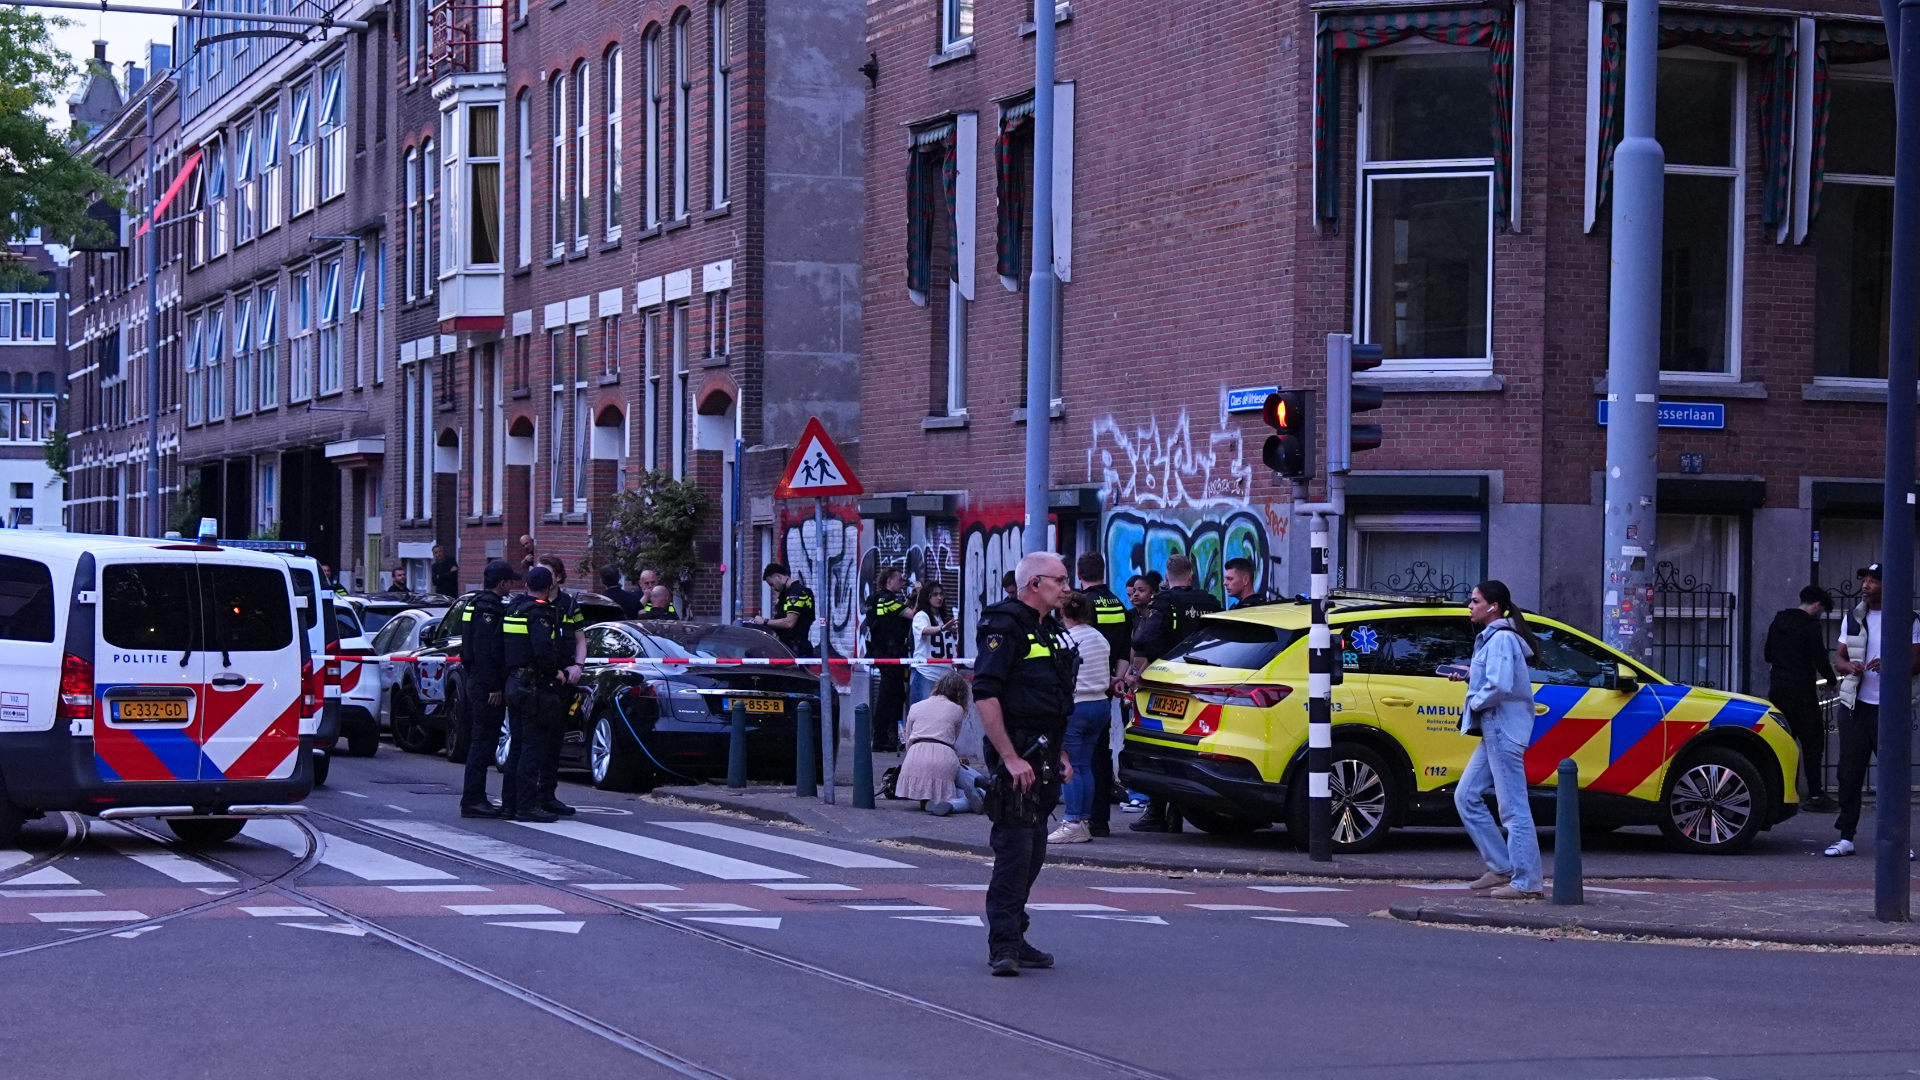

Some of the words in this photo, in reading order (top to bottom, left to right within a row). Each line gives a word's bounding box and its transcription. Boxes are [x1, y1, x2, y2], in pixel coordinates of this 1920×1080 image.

[1657, 408, 1715, 421] esserlaan
[113, 654, 168, 664] POLITIE
[124, 703, 182, 717] G-332-GD
[731, 700, 780, 711] -855-B
[1153, 697, 1185, 713] HKX-30-S
[1417, 705, 1463, 716] AMBUL
